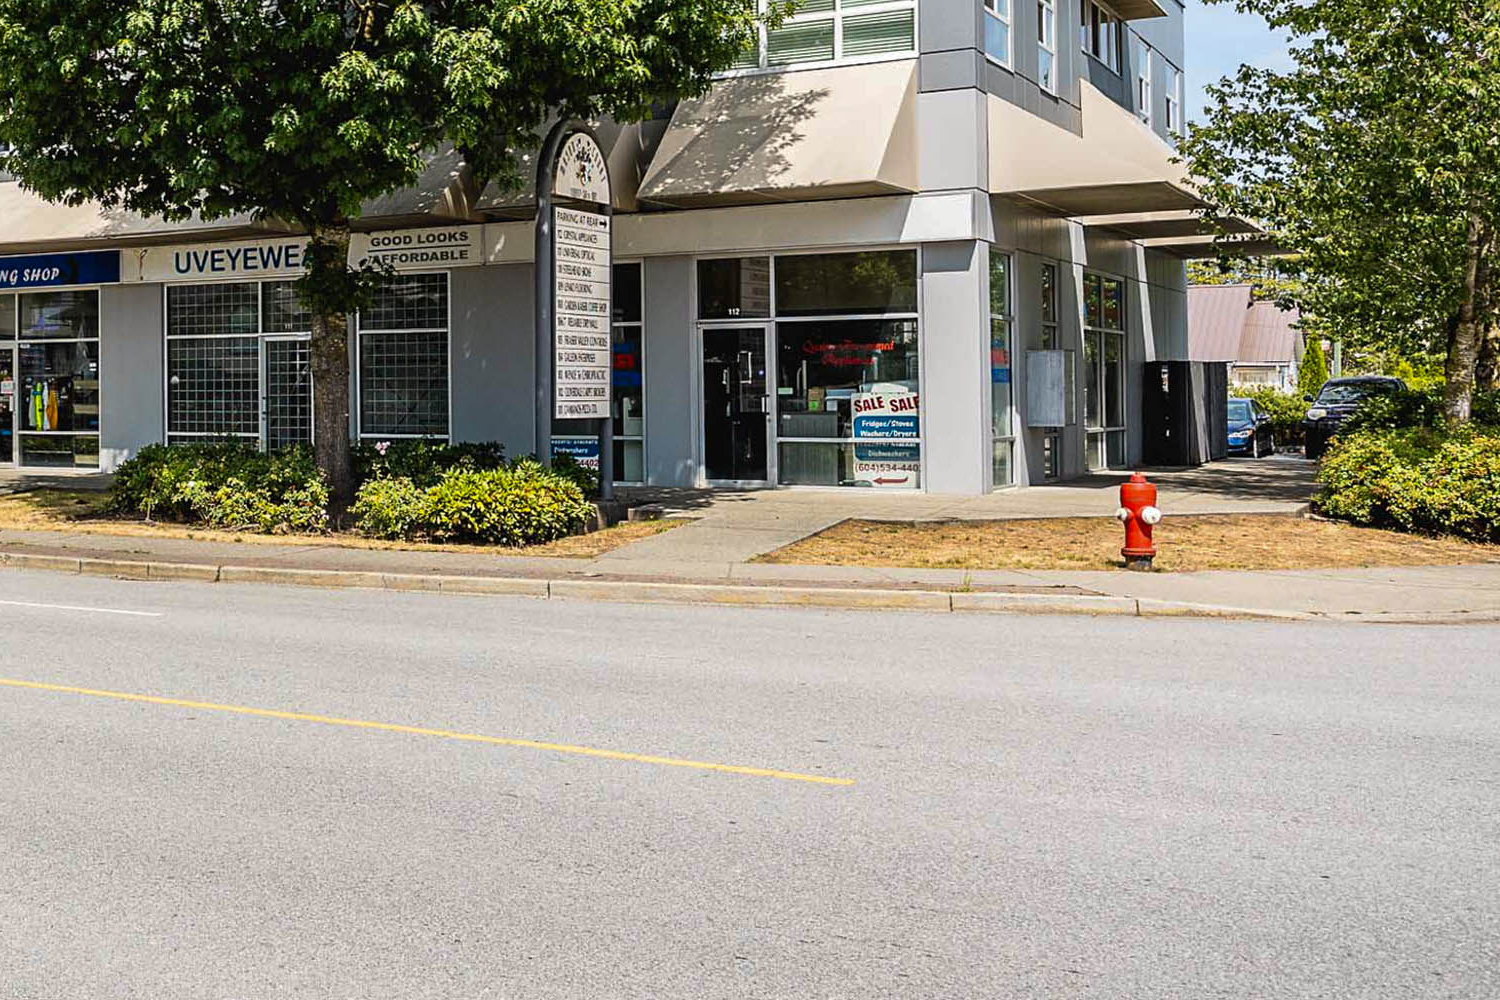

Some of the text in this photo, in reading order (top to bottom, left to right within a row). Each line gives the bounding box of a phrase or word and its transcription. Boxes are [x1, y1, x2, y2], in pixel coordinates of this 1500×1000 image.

[370, 231, 469, 248] GOOD LOOKS
[175, 244, 311, 274] UVEYEWE
[371, 249, 469, 265] AFFORDABLE
[23, 267, 60, 282] SHOP
[728, 307, 740, 316] 112
[853, 396, 885, 413] SALE
[855, 463, 921, 473] (604)534-440
